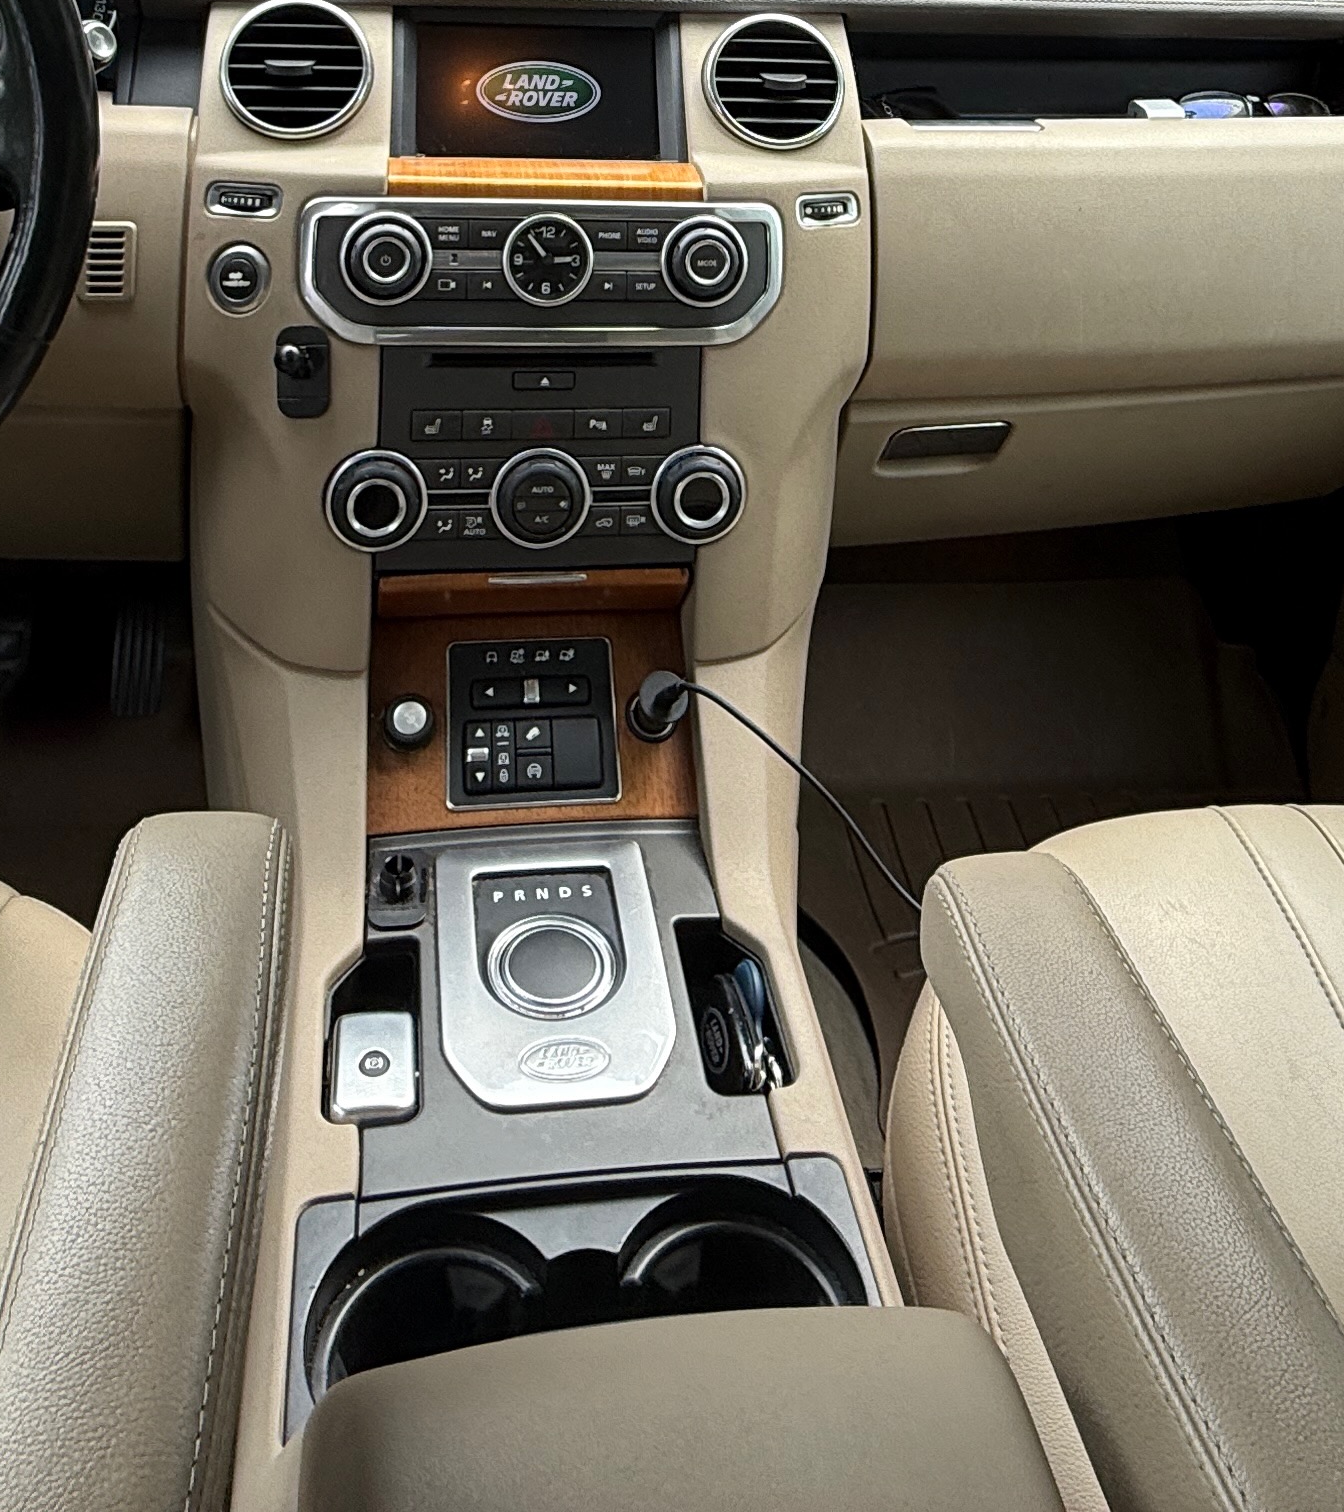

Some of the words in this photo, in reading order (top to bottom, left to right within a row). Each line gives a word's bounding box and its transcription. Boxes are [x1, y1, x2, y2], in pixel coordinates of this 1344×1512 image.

[503, 74, 560, 90] LAND
[506, 90, 579, 108] ROVER
[481, 230, 498, 238] NAV
[541, 226, 556, 238] 12
[598, 231, 621, 240] PHONE
[636, 228, 659, 236] AUDIO
[438, 234, 460, 242] MENU
[637, 236, 658, 244] VIDEO
[513, 254, 523, 265] 9
[571, 254, 581, 267] 3
[697, 259, 718, 267] MODE
[541, 282, 551, 295] 6
[635, 283, 657, 291] SETUP
[597, 463, 616, 471] MAX
[531, 486, 554, 494] AUTO
[534, 515, 550, 524] A/C
[463, 528, 486, 536] AUTO
[493, 890, 504, 903] P
[514, 889, 526, 902] R
[535, 887, 549, 900] N
[558, 886, 572, 898] D
[581, 884, 593, 898] S
[709, 1018, 724, 1048] LAND
[539, 1045, 581, 1060] LAND
[548, 1055, 596, 1070] ROVER
